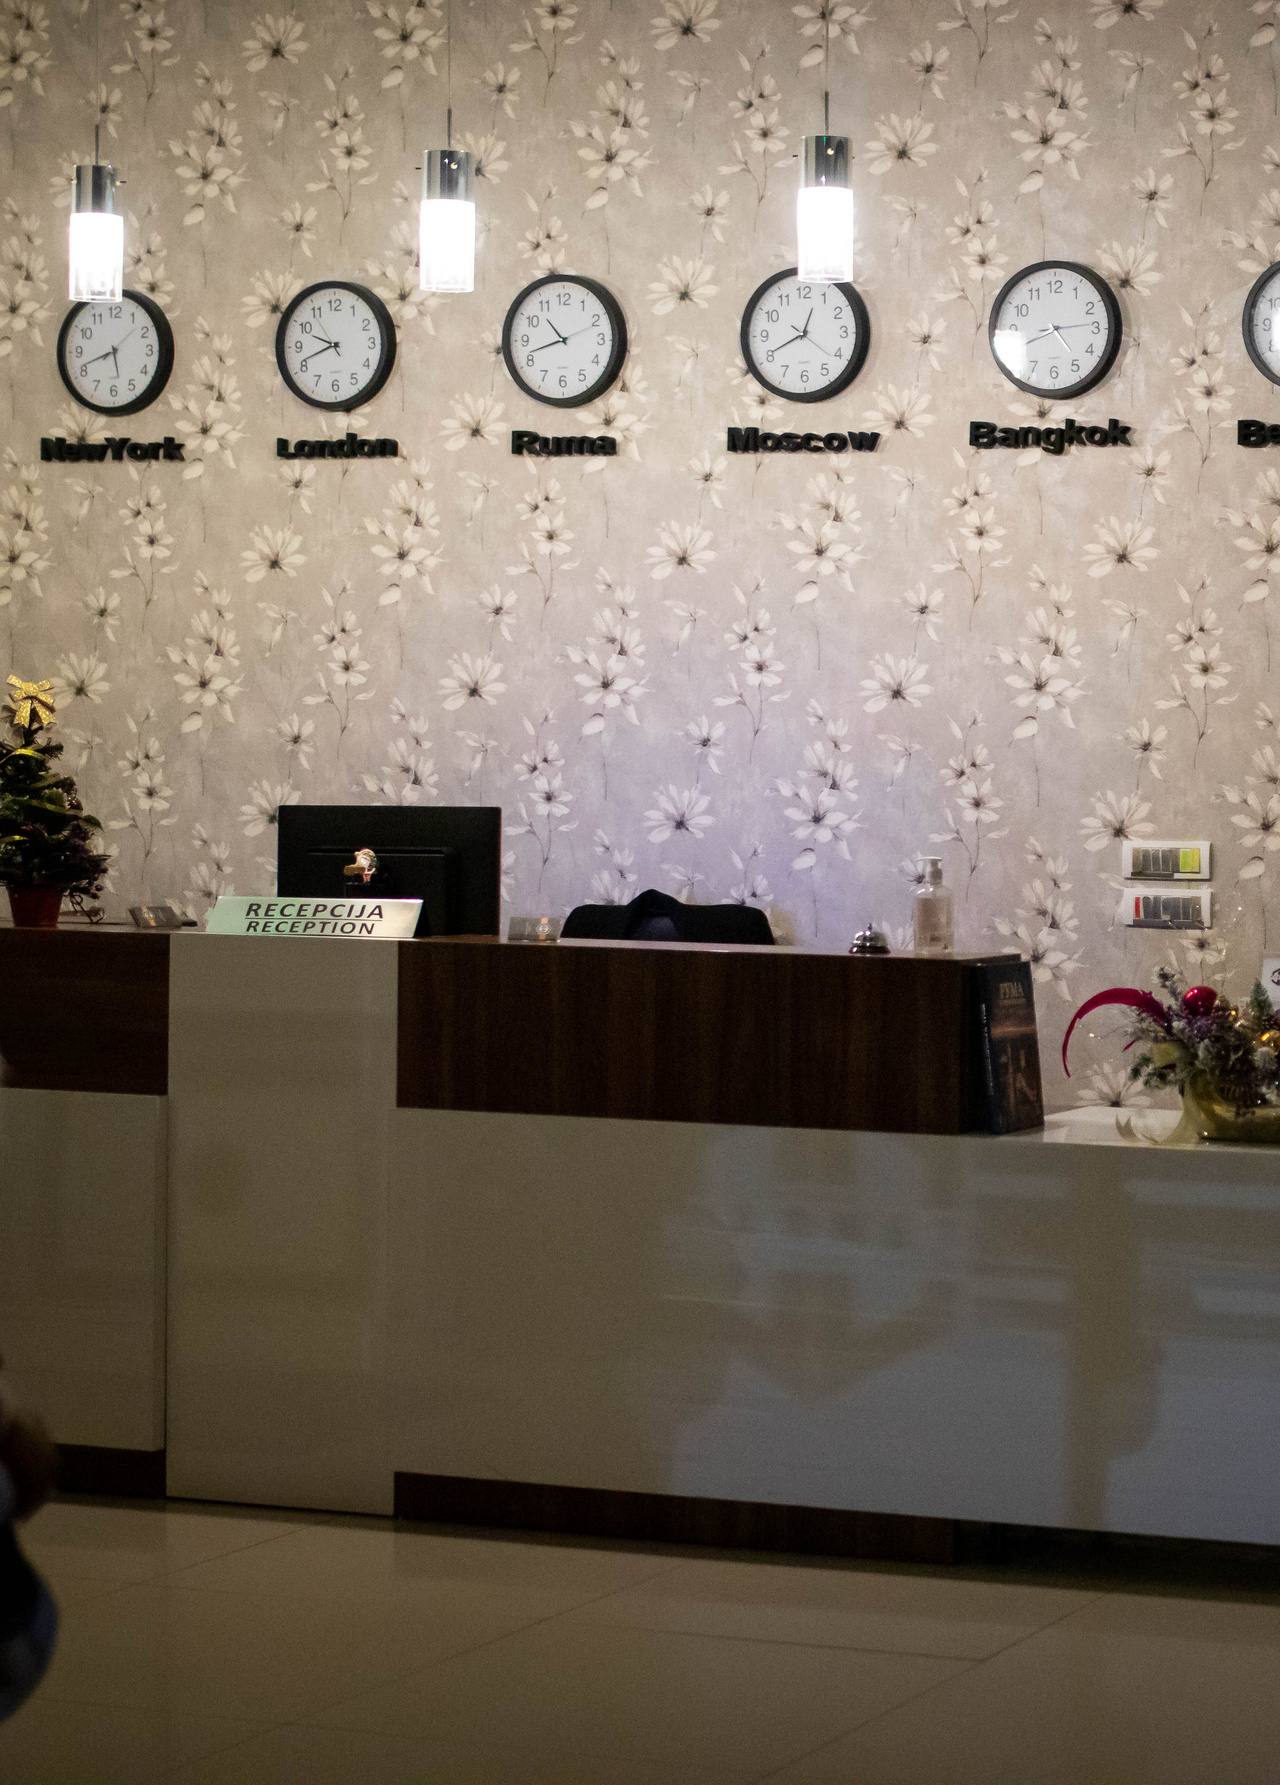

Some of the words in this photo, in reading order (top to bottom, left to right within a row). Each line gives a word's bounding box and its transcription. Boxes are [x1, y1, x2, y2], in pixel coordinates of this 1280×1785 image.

[796, 286, 811, 299] 12
[1047, 280, 1063, 294] 12
[1073, 287, 1078, 299] 1
[556, 293, 571, 306] 12
[778, 294, 790, 306] 11
[821, 292, 826, 304] 1
[1028, 288, 1040, 300] 11
[327, 299, 342, 311] 12
[351, 305, 355, 316] 1
[539, 300, 550, 312] 11
[580, 300, 585, 312] 1
[1014, 304, 1029, 317] 10
[1086, 302, 1094, 315] 2
[92, 313, 103, 324] 11
[108, 306, 122, 319] 12
[130, 312, 135, 324] 1
[311, 307, 322, 318] 11
[765, 310, 779, 322] 10
[834, 307, 843, 319] 2
[362, 319, 370, 331] 2
[526, 315, 539, 328] 10
[592, 314, 600, 327] 2
[1263, 318, 1271, 331] 9
[141, 327, 149, 338] 2
[300, 322, 312, 334] 10
[840, 326, 848, 338] 3
[1092, 321, 1100, 334] 3
[80, 328, 92, 340] 10
[597, 333, 605, 345] 3
[760, 330, 769, 342] 9
[295, 341, 303, 353] 9
[368, 337, 376, 349] 3
[521, 335, 529, 347] 9
[76, 346, 83, 358] 9
[146, 344, 153, 356] 3
[834, 347, 843, 359] 4
[1085, 343, 1094, 356] 4
[527, 354, 534, 367] 8
[592, 354, 600, 365] 4
[767, 350, 775, 362] 8
[300, 360, 308, 372] 8
[363, 358, 370, 369] 4
[821, 363, 829, 376] 5
[1030, 361, 1038, 373] 7
[1071, 359, 1080, 372] 5
[80, 364, 87, 377] 8
[140, 365, 148, 376] 4
[540, 370, 548, 382] 7
[578, 369, 586, 382] 5
[781, 365, 789, 378] 7
[801, 370, 809, 383] 6
[1050, 366, 1059, 379] 6
[128, 379, 136, 391] 5
[313, 375, 321, 387] 7
[350, 373, 358, 385] 5
[559, 375, 567, 388] 6
[93, 380, 100, 392] 7
[110, 385, 118, 397] 6
[332, 380, 340, 392] 6
[727, 427, 881, 453] Moscow
[969, 418, 1132, 455] Bangkok
[276, 433, 399, 459] London
[511, 430, 617, 456] Ruma
[245, 902, 384, 919] RECEPCIJA
[246, 921, 375, 935] RECEPTION
